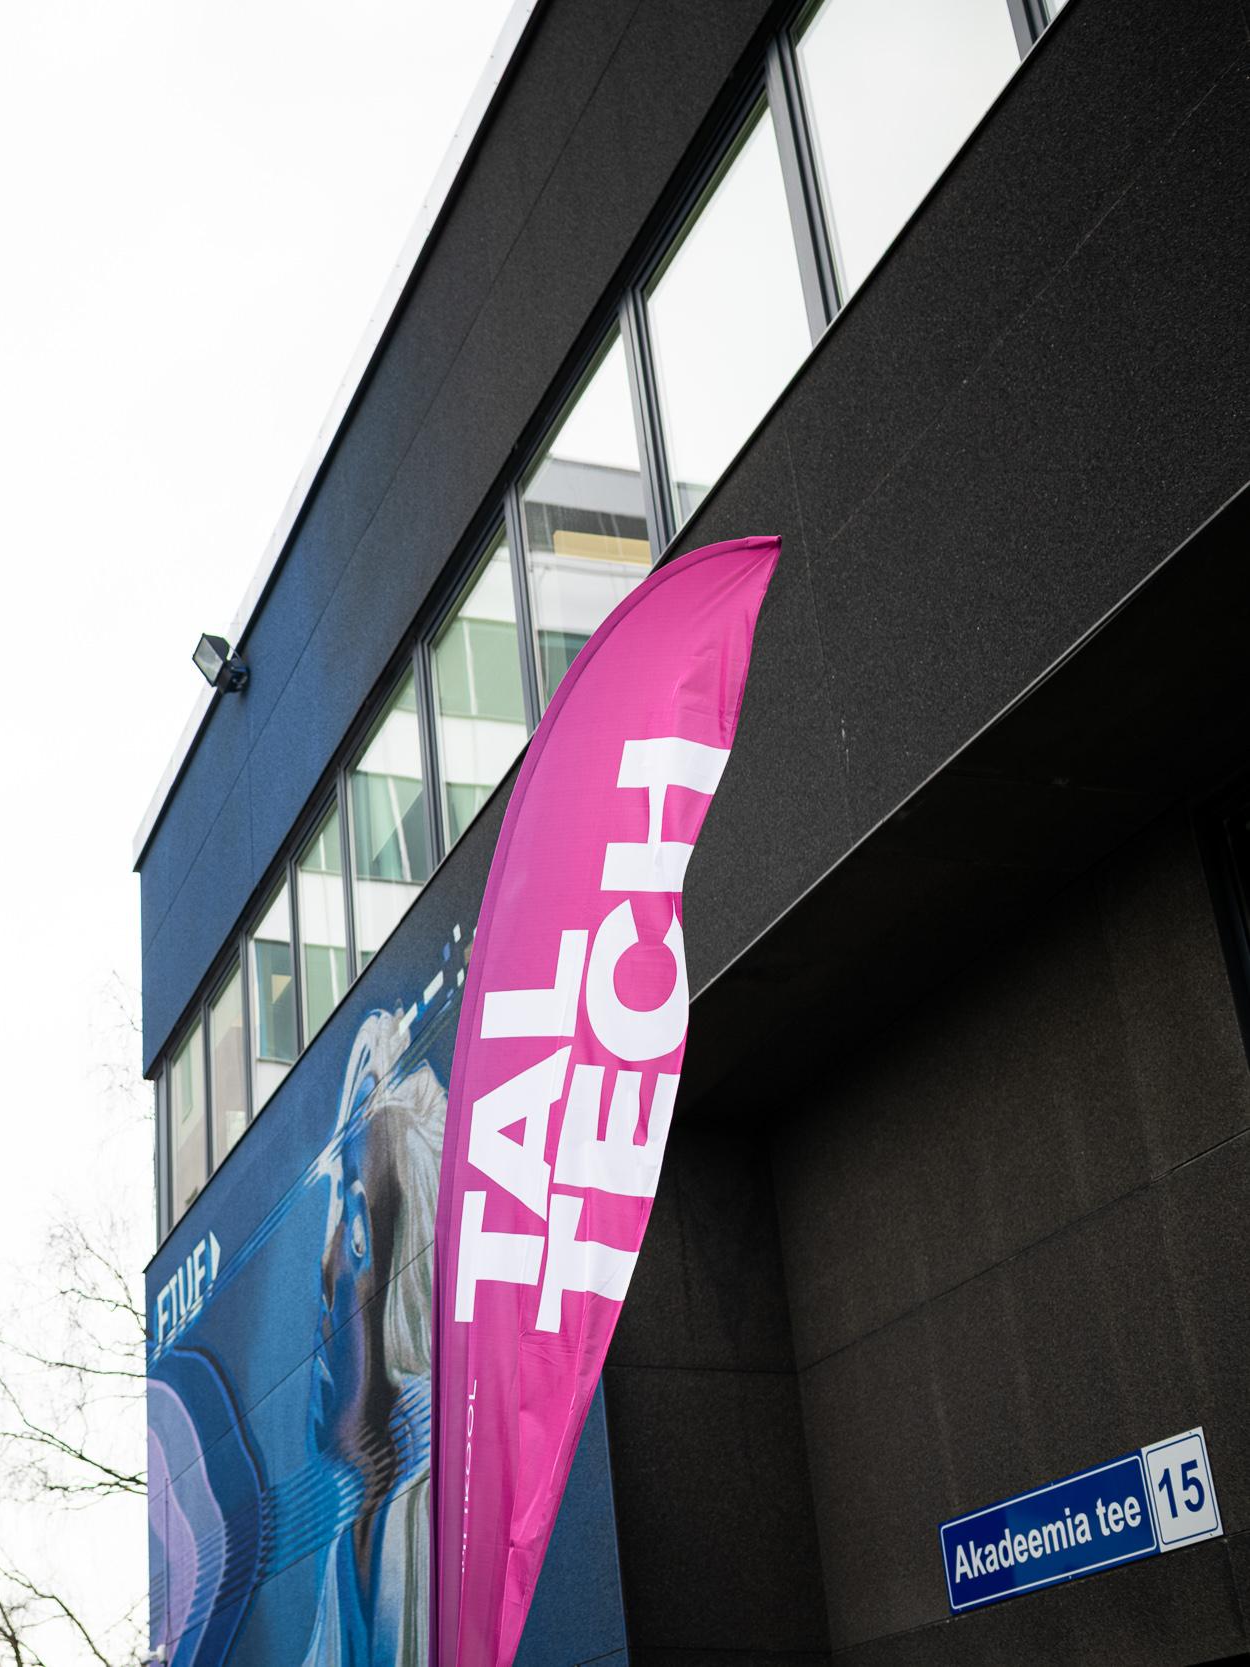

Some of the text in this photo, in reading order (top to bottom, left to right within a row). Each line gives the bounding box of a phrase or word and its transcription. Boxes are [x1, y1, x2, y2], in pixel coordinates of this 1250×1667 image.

[455, 930, 589, 1322] TAL
[535, 737, 731, 1333] TECH
[955, 1459, 1206, 1583] Akadeemia tee 15
